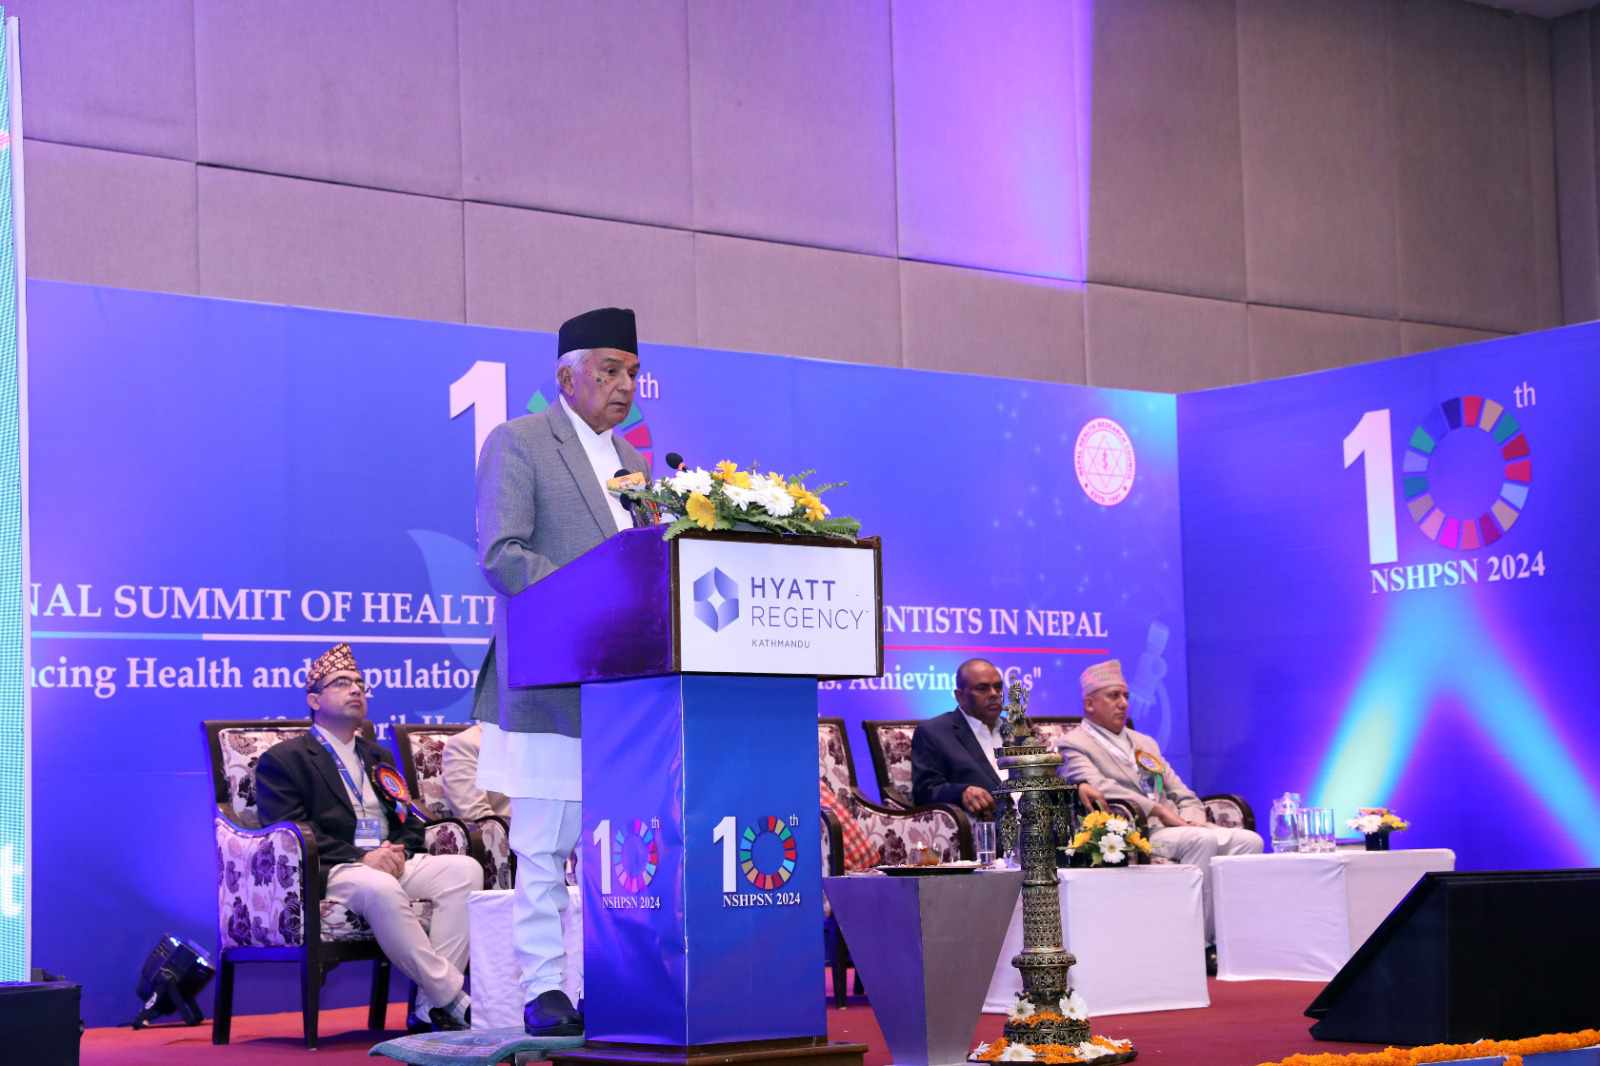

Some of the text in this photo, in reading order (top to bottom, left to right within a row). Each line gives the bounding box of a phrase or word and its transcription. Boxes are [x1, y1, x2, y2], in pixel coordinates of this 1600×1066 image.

[1370, 550, 1546, 594] NSHPSN 2024
[751, 577, 836, 601] HYATT
[114, 584, 290, 622] SUMMIT
[301, 590, 352, 623] OF
[883, 605, 983, 635] NTISTS
[989, 608, 1019, 635] IN
[1025, 609, 1108, 637] NEPAL
[751, 605, 864, 630] REGENCY
[751, 639, 811, 649] KATHMANDU
[127, 657, 241, 689] Health
[602, 896, 660, 909] NSHPSN 2024
[723, 891, 800, 908] NSHPSN 2024
